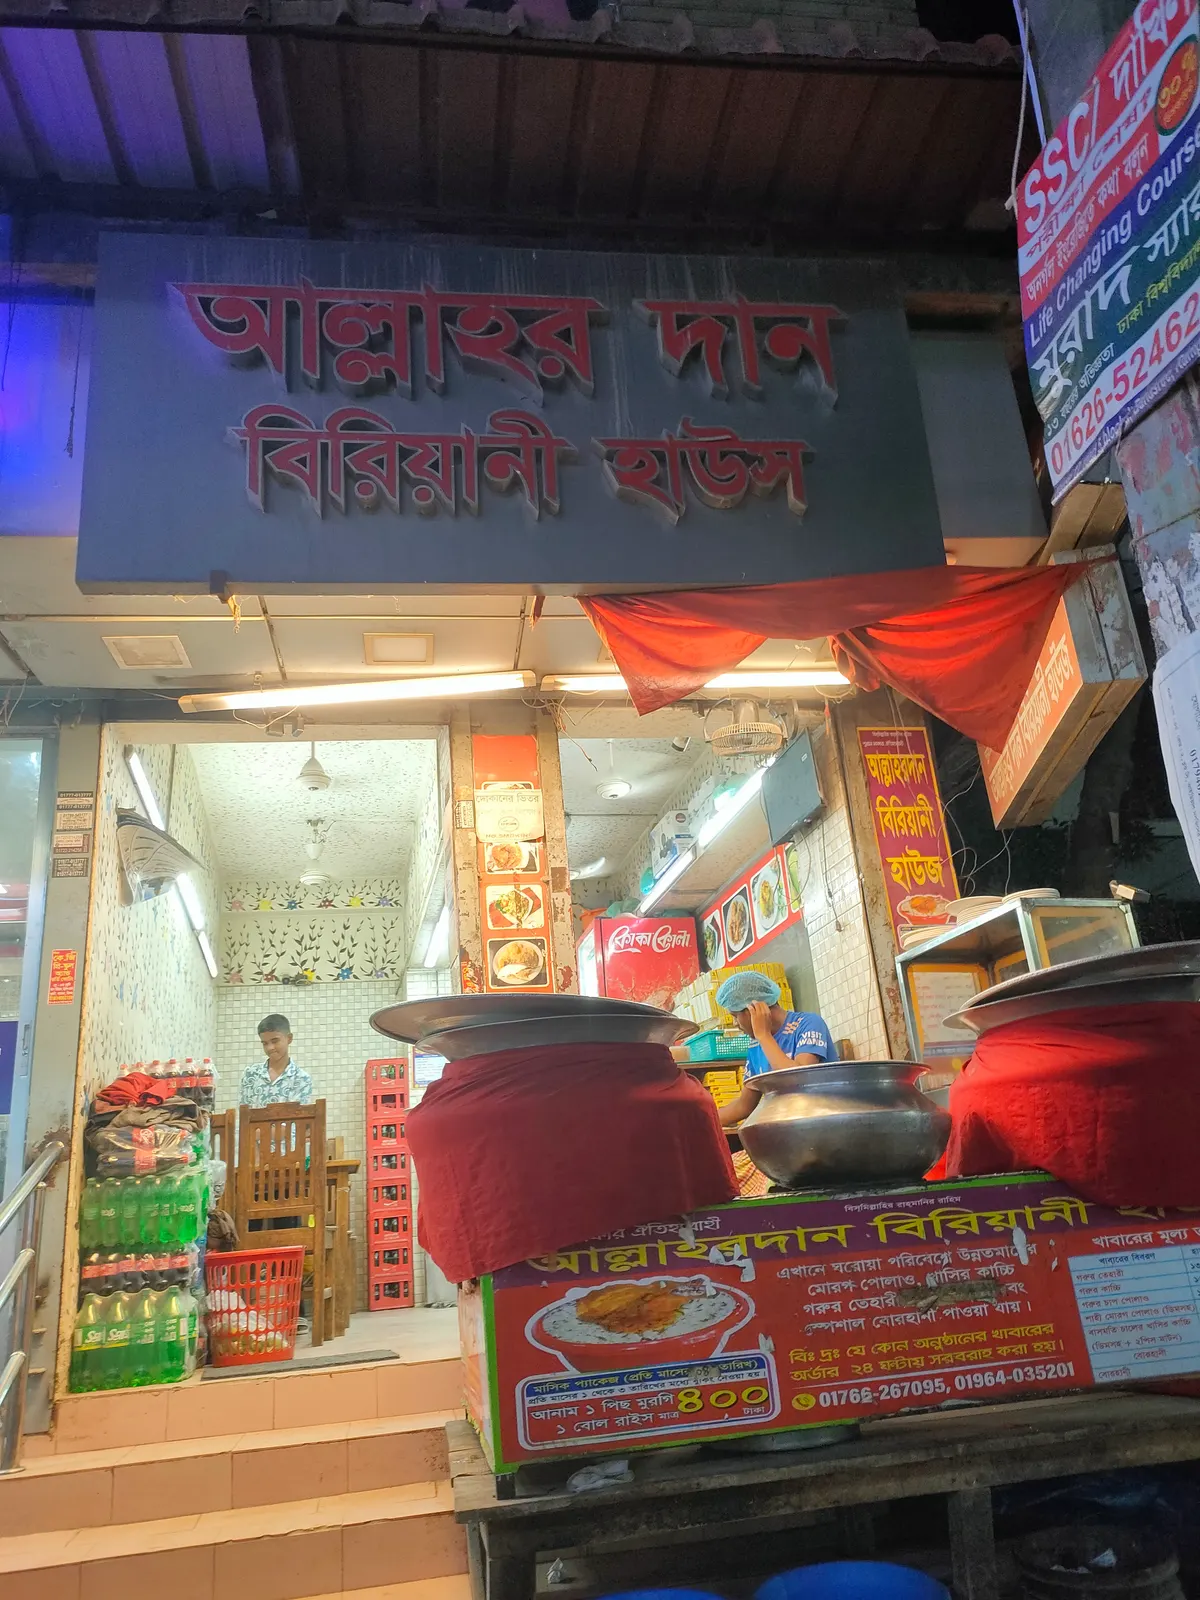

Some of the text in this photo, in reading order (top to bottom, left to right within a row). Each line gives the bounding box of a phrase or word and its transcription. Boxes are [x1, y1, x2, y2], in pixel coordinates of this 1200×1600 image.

[1025, 76, 1100, 233] SSC/
[1097, 167, 1120, 208] কথা
[1122, 133, 1149, 178] বলুন
[1029, 305, 1054, 348] Life
[1057, 210, 1132, 311] Changing
[1032, 245, 1140, 397] মুরাদ
[1116, 299, 1144, 334] ঢাকা
[165, 276, 848, 406] আল্লাহর দান
[1078, 342, 1117, 389] অভিজ্ঞতা
[228, 404, 815, 523] বিরিয়ানী হাউস
[875, 793, 937, 839] বিরিয়ানী
[885, 845, 945, 894] হাউজ
[802, 1030, 822, 1039] VISIT
[867, 1196, 1096, 1245] বিরিয়ানী
[1091, 1231, 1154, 1249] খাবারের
[1156, 1228, 1189, 1244] মূল্য
[776, 1263, 825, 1280] এখানে
[831, 1256, 882, 1275] ঘরোয়া
[975, 1261, 1016, 1279] কাচ্চি
[1099, 1255, 1130, 1266] খাবারের
[1076, 1273, 1095, 1282] গরুর
[1079, 1286, 1098, 1296] গরুর
[803, 1300, 842, 1317] গরুর
[848, 1290, 900, 1312] তেহারী
[942, 1303, 989, 1322] পাওয়া
[994, 1299, 1022, 1315] যায়
[1082, 1301, 1101, 1310] গরুর
[846, 1344, 867, 1358] যে
[871, 1338, 909, 1355] কোন
[913, 1330, 988, 1351] অনুষ্ঠানের
[991, 1322, 1055, 1340] খাবারের
[789, 1365, 840, 1382] অর্ডার
[852, 1363, 873, 1376] ২৪
[929, 1348, 993, 1366] সরবরাহ
[996, 1342, 1028, 1358] করা
[954, 1361, 1076, 1391] 01964-035201
[527, 1395, 548, 1406] প্রতি
[550, 1392, 579, 1402] মাসের
[591, 1388, 615, 1397] থেকে
[628, 1379, 667, 1392] তারিখের
[533, 1381, 571, 1394] মাসিক
[574, 1375, 620, 1388] প্যাকেজ
[623, 1370, 653, 1384] (প্রতি
[530, 1405, 580, 1422] আনাম
[586, 1404, 595, 1416] ১
[600, 1398, 633, 1414] পিছ
[677, 1385, 769, 1414] ৪০০
[743, 1405, 766, 1416] টাকা
[556, 1410, 680, 1436] ১ বোল রাইস মাত্র
